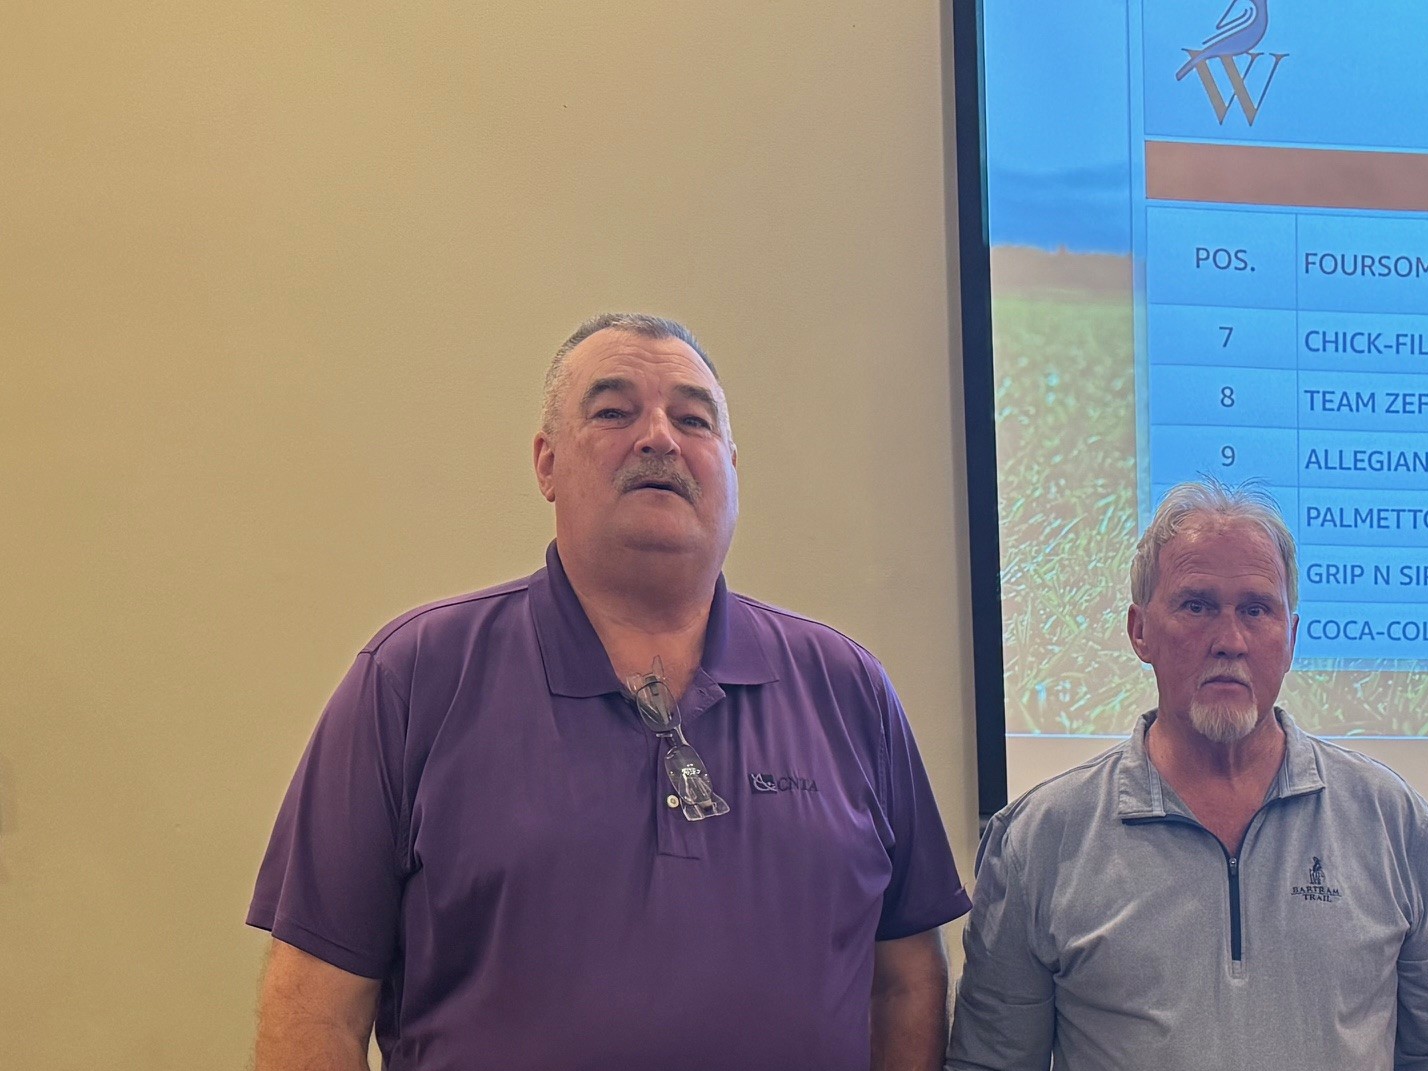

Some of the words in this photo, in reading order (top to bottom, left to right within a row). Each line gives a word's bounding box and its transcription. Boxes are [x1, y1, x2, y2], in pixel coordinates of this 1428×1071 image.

[1194, 247, 1256, 272] POS.
[1219, 327, 1233, 348] 7
[1220, 387, 1235, 408] 8
[1305, 389, 1377, 414] TEAM
[1220, 446, 1235, 466] 9
[1306, 563, 1365, 586] GRIP
[1374, 565, 1390, 586] N
[1292, 886, 1339, 895] BARTRAM
